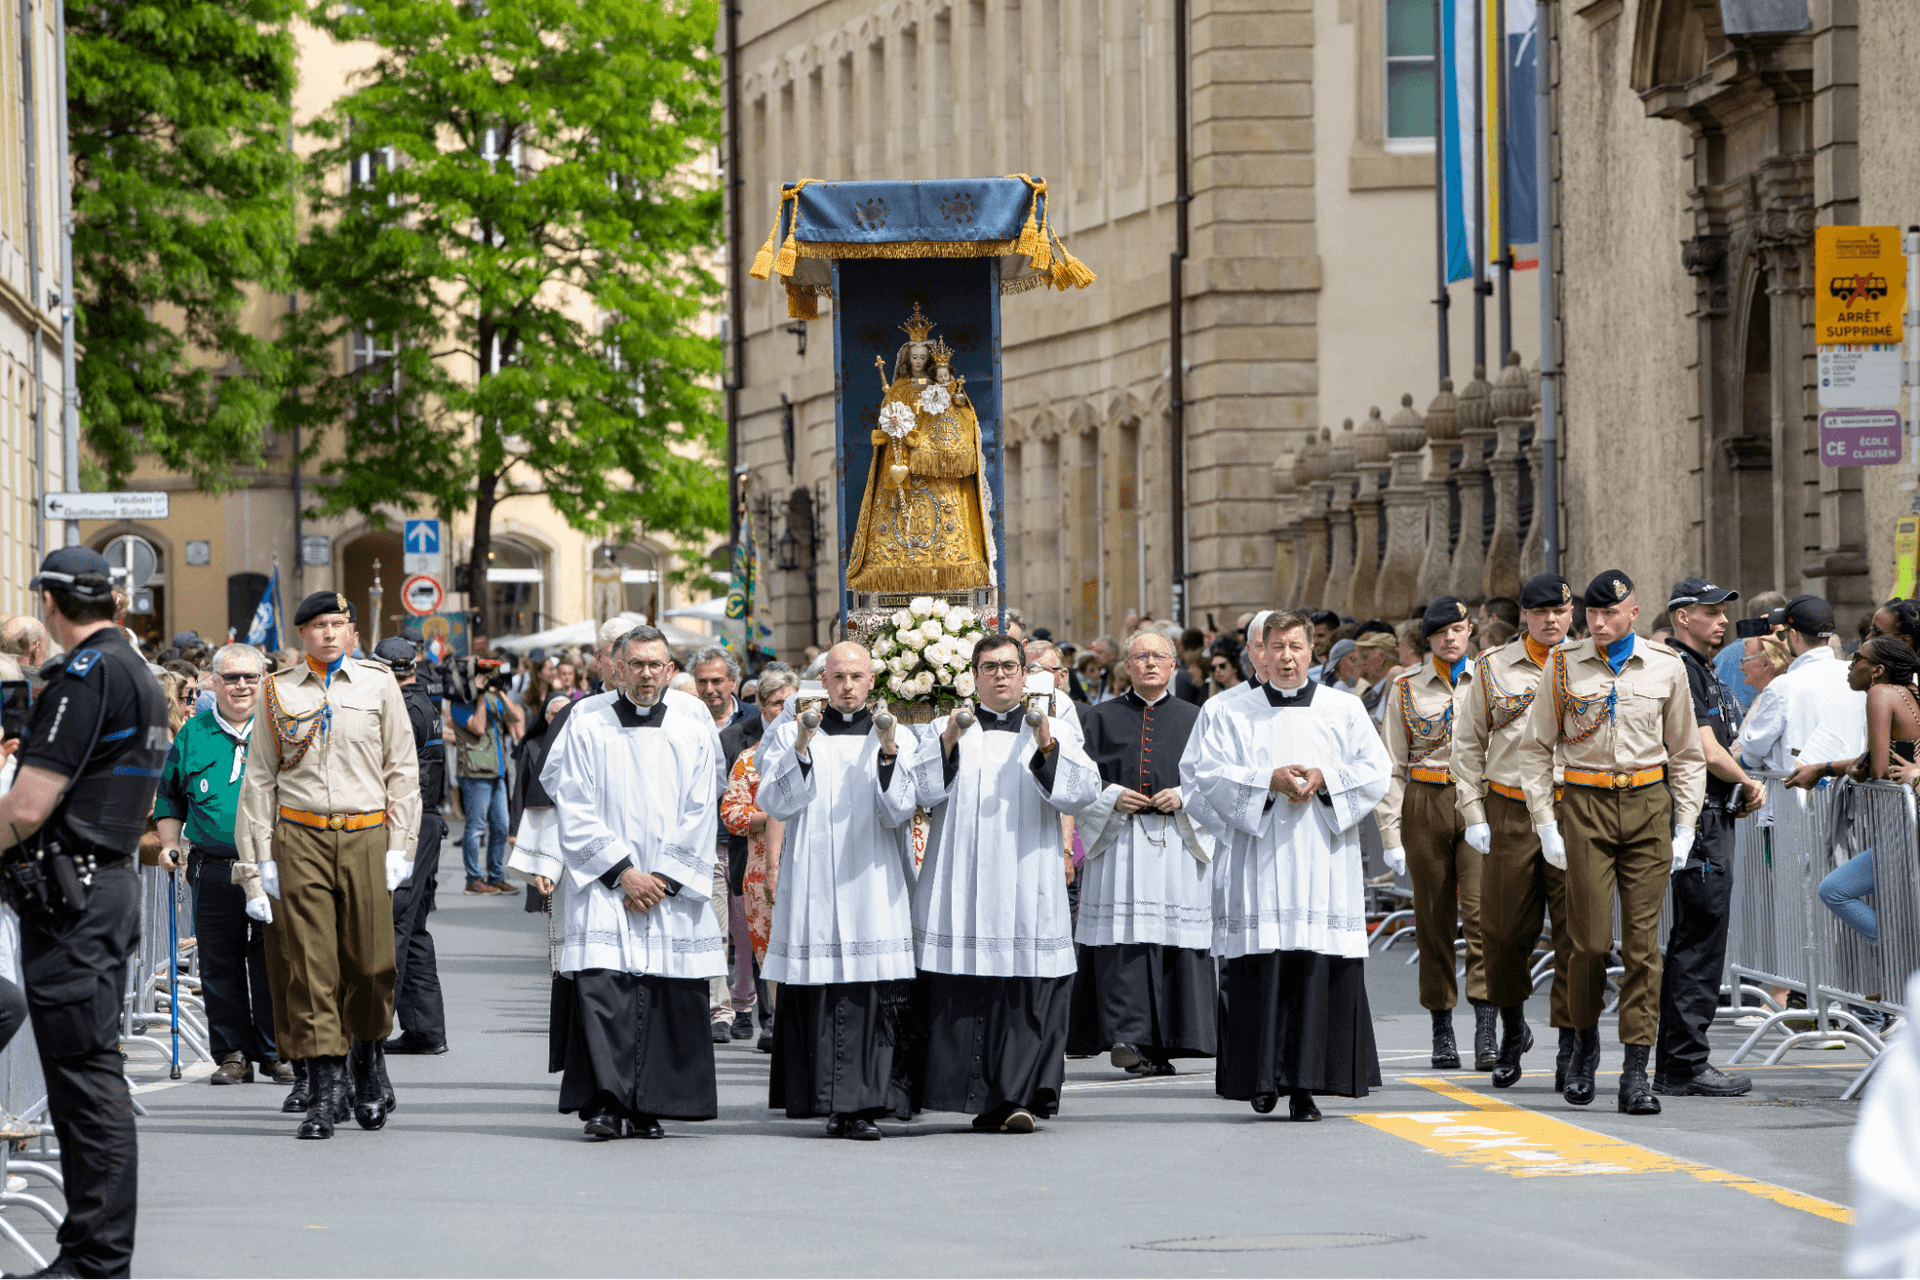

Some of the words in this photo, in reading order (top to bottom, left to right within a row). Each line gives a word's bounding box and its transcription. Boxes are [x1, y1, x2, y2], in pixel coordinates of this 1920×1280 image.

[1837, 308, 1881, 323] ARRÊT
[1826, 322, 1893, 337] SUPPRIMÉ
[1859, 435, 1889, 447] ÉCOLE
[1826, 440, 1847, 456] CE
[1852, 448, 1896, 459] CLAUSEN
[113, 496, 153, 504] Vauban
[64, 507, 117, 517] Guillaume
